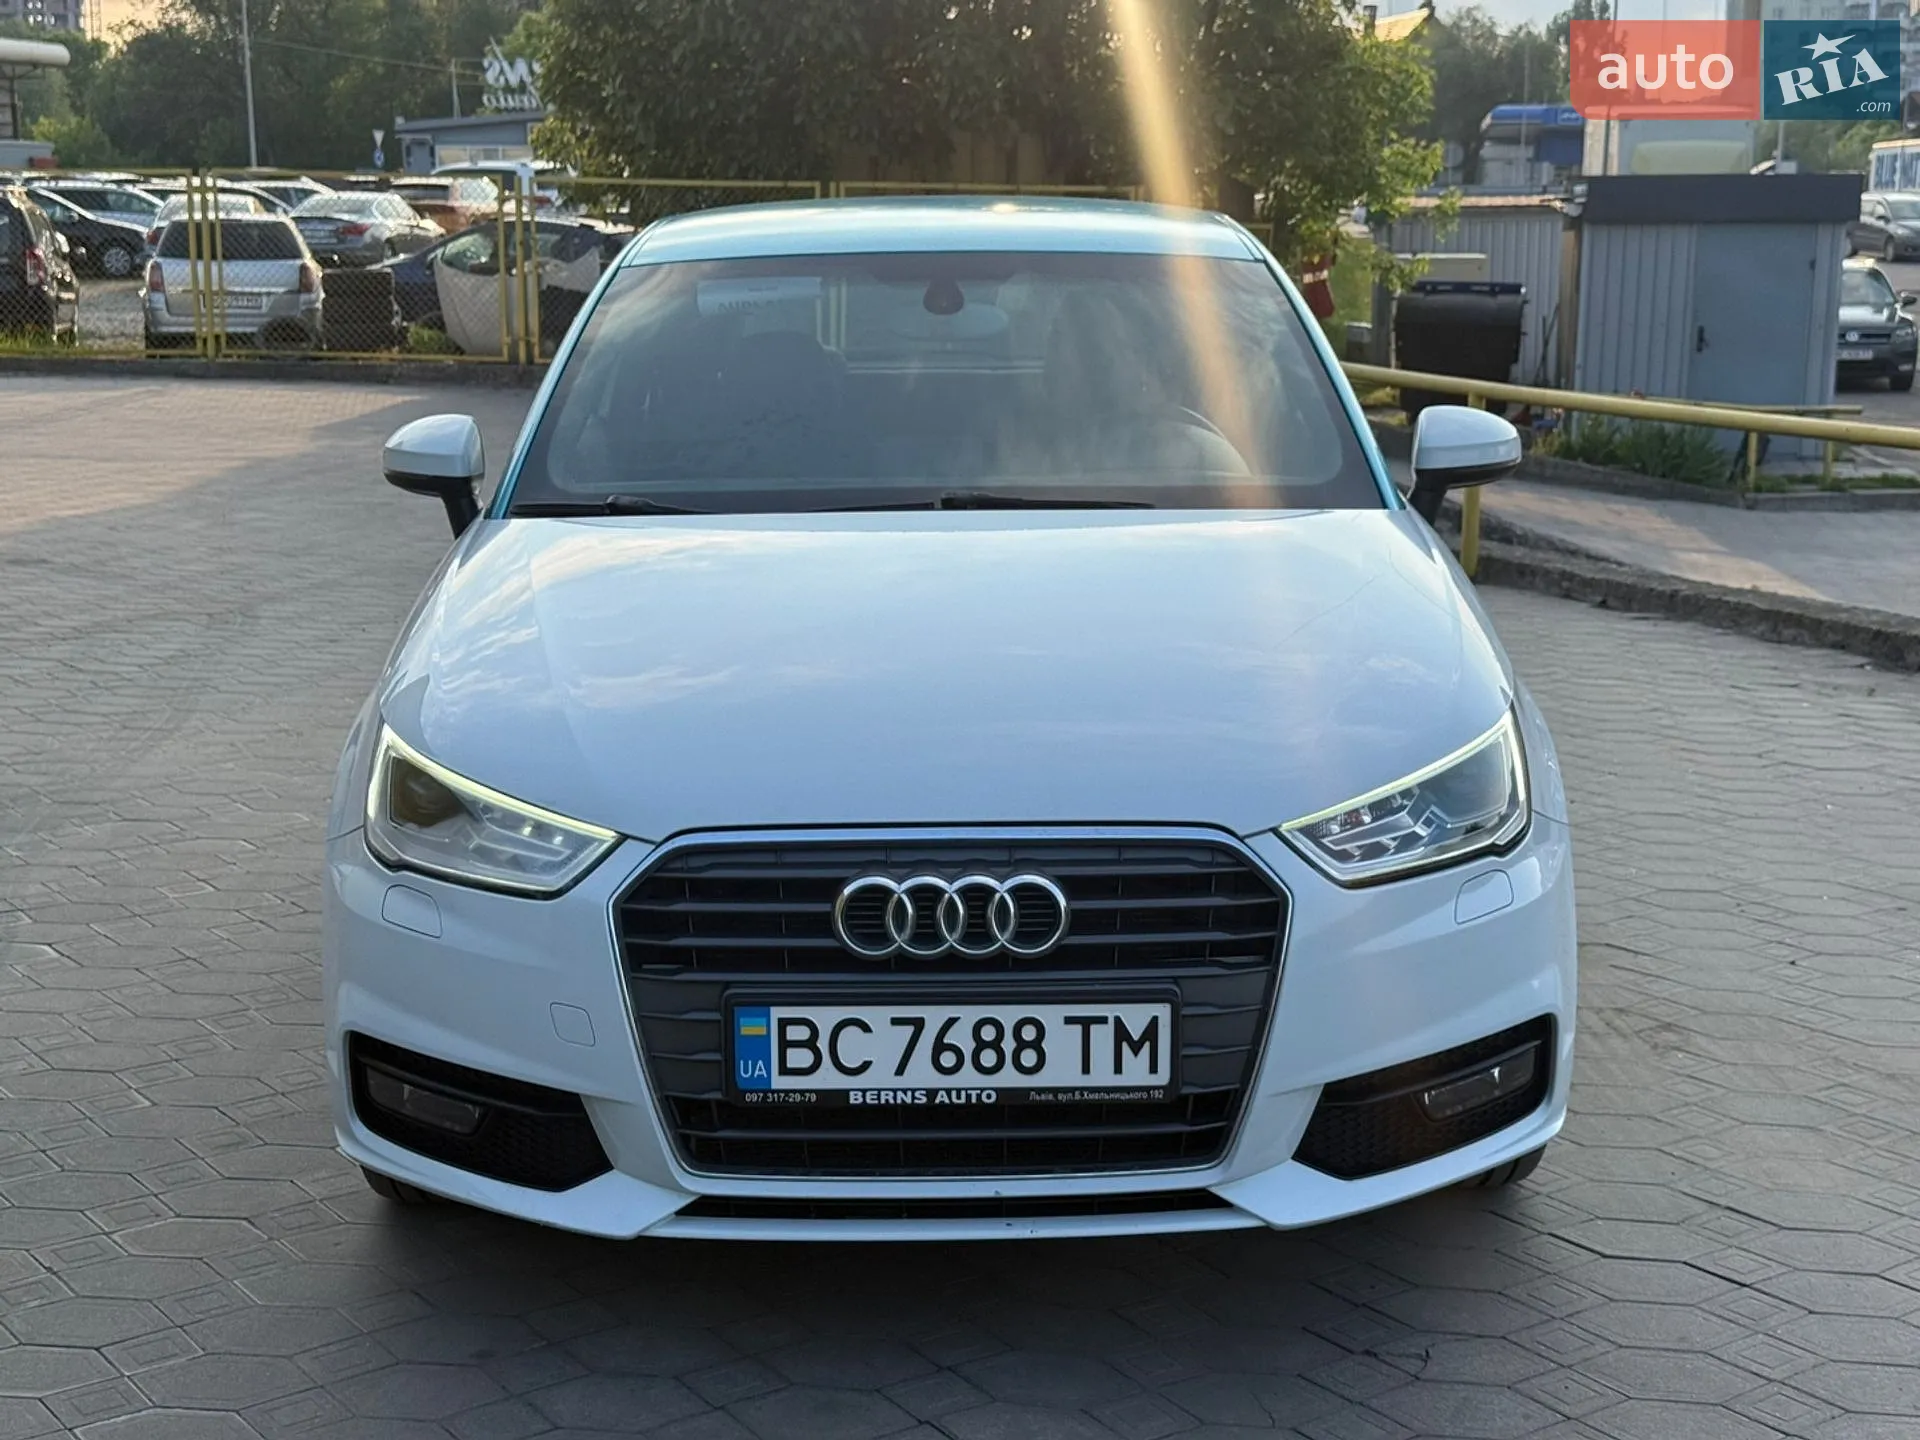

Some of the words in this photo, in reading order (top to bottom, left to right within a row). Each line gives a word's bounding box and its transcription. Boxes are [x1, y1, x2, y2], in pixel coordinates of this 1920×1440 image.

[776, 1016, 873, 1077] BC
[890, 1016, 1046, 1077] 7688
[1064, 1015, 1159, 1075] TM
[740, 1060, 767, 1078] UA
[849, 1090, 928, 1105] BERNS
[934, 1089, 997, 1104] AUTO
